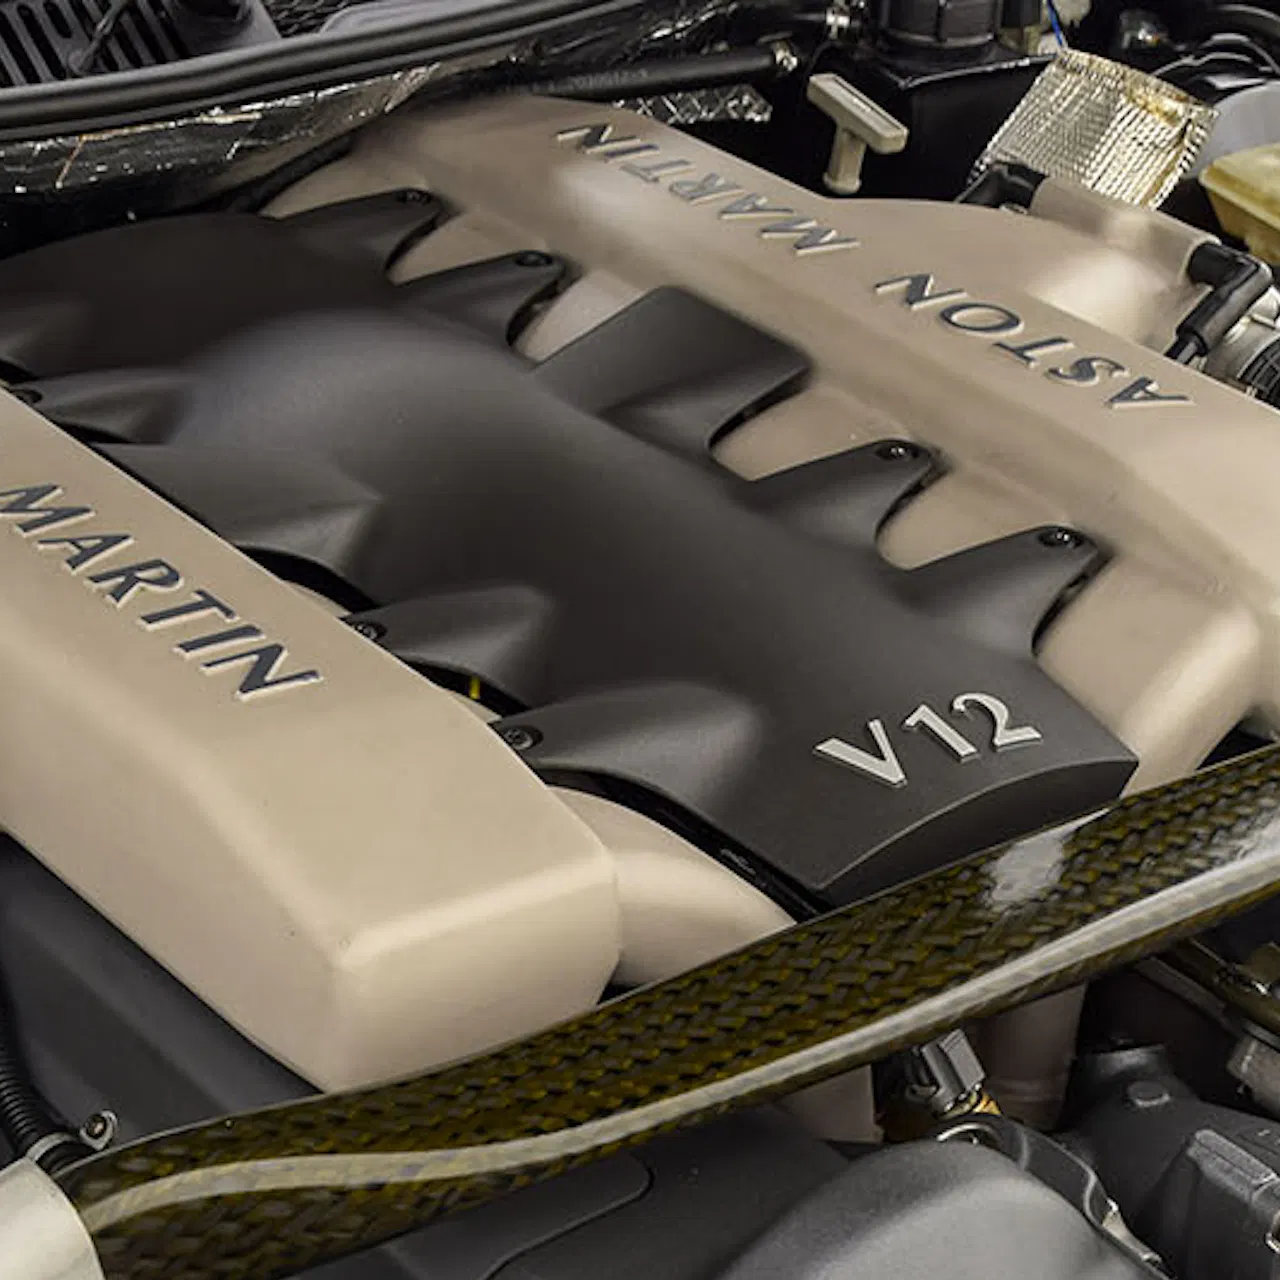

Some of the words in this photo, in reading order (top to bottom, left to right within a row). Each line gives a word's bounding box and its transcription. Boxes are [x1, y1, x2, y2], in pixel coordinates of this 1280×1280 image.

[556, 122, 862, 256] MARTIN
[874, 272, 1197, 411] ASTON
[813, 691, 1042, 787] V12
